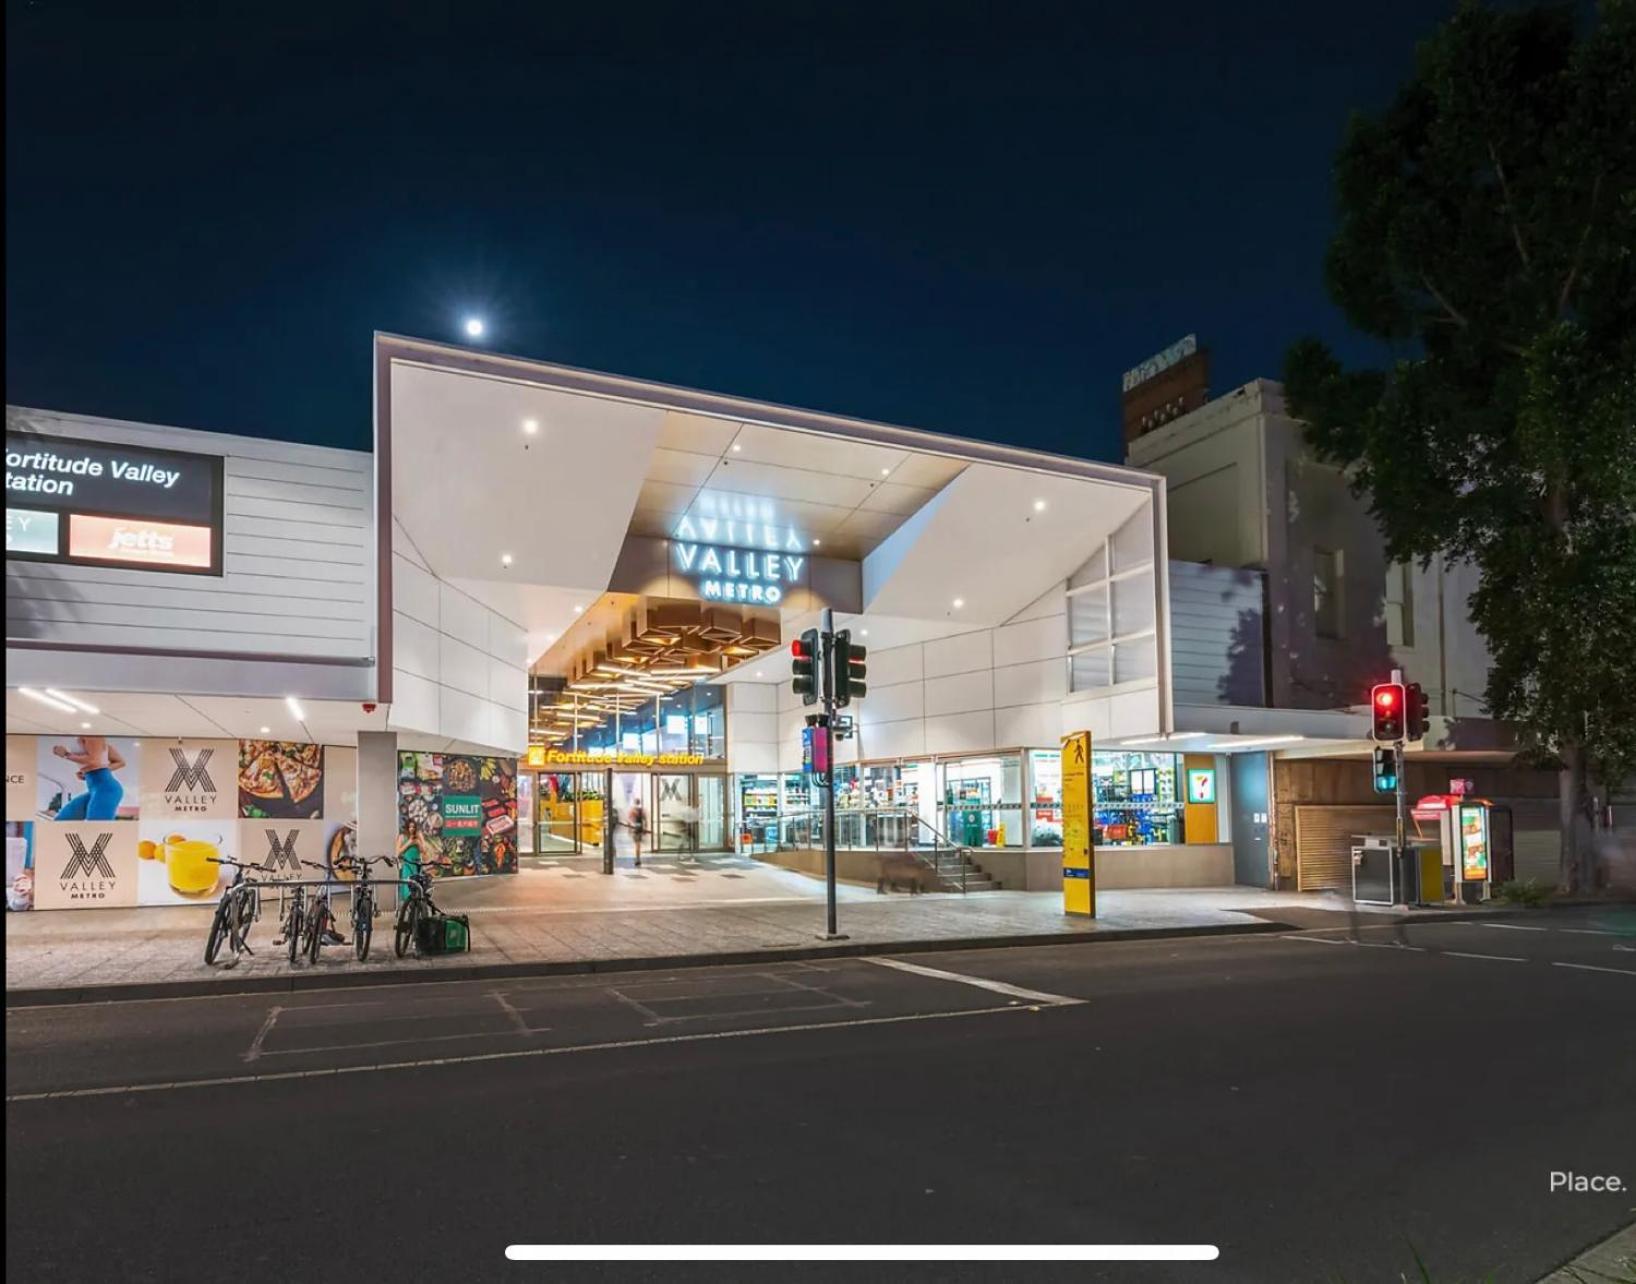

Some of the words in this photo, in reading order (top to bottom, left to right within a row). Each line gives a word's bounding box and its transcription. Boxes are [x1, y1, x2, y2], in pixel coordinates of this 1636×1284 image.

[6, 447, 103, 476] ortitude
[111, 460, 180, 488] Valley
[108, 527, 174, 550] jetts
[675, 543, 804, 582] VALLEY
[704, 580, 782, 603] METRO
[164, 795, 217, 805] VALLEY
[445, 803, 480, 814] SUNLIT
[59, 881, 116, 891] VALLEY
